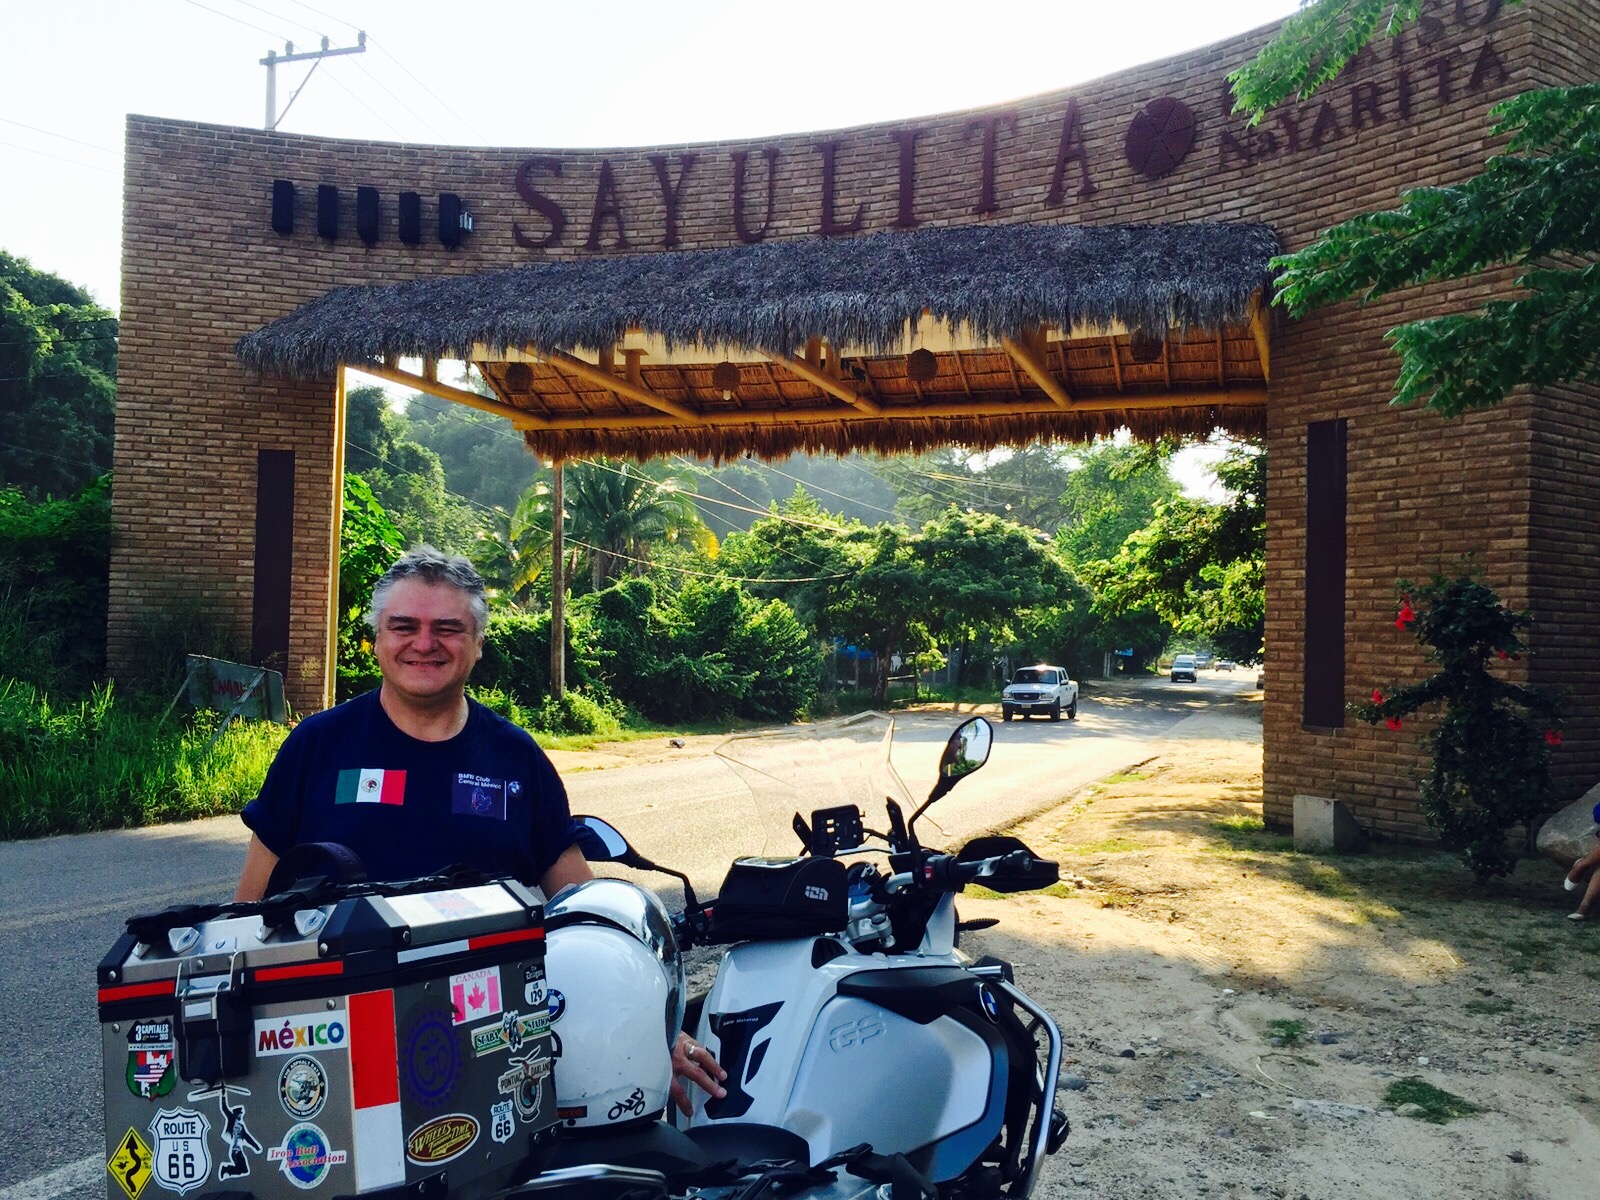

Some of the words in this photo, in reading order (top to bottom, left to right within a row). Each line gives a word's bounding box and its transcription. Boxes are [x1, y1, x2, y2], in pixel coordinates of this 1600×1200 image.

[512, 97, 1098, 251] SAYULITA
[458, 778, 480, 787] Central
[455, 969, 493, 983] CANADA
[532, 982, 540, 990] US
[530, 988, 543, 1003] 129
[135, 1024, 142, 1041] 3
[141, 1023, 169, 1034] CAPITALES
[829, 1012, 887, 1054] GS
[500, 1071, 523, 1091] PONTIAC
[493, 1102, 511, 1115] ROUTE
[498, 1113, 507, 1121] US
[163, 1121, 196, 1135] ROUTE
[495, 1120, 511, 1139] 66
[270, 1149, 294, 1159] Iron
[295, 1144, 320, 1156] Butt
[168, 1153, 195, 1179] 66
[285, 1152, 345, 1169] Association
